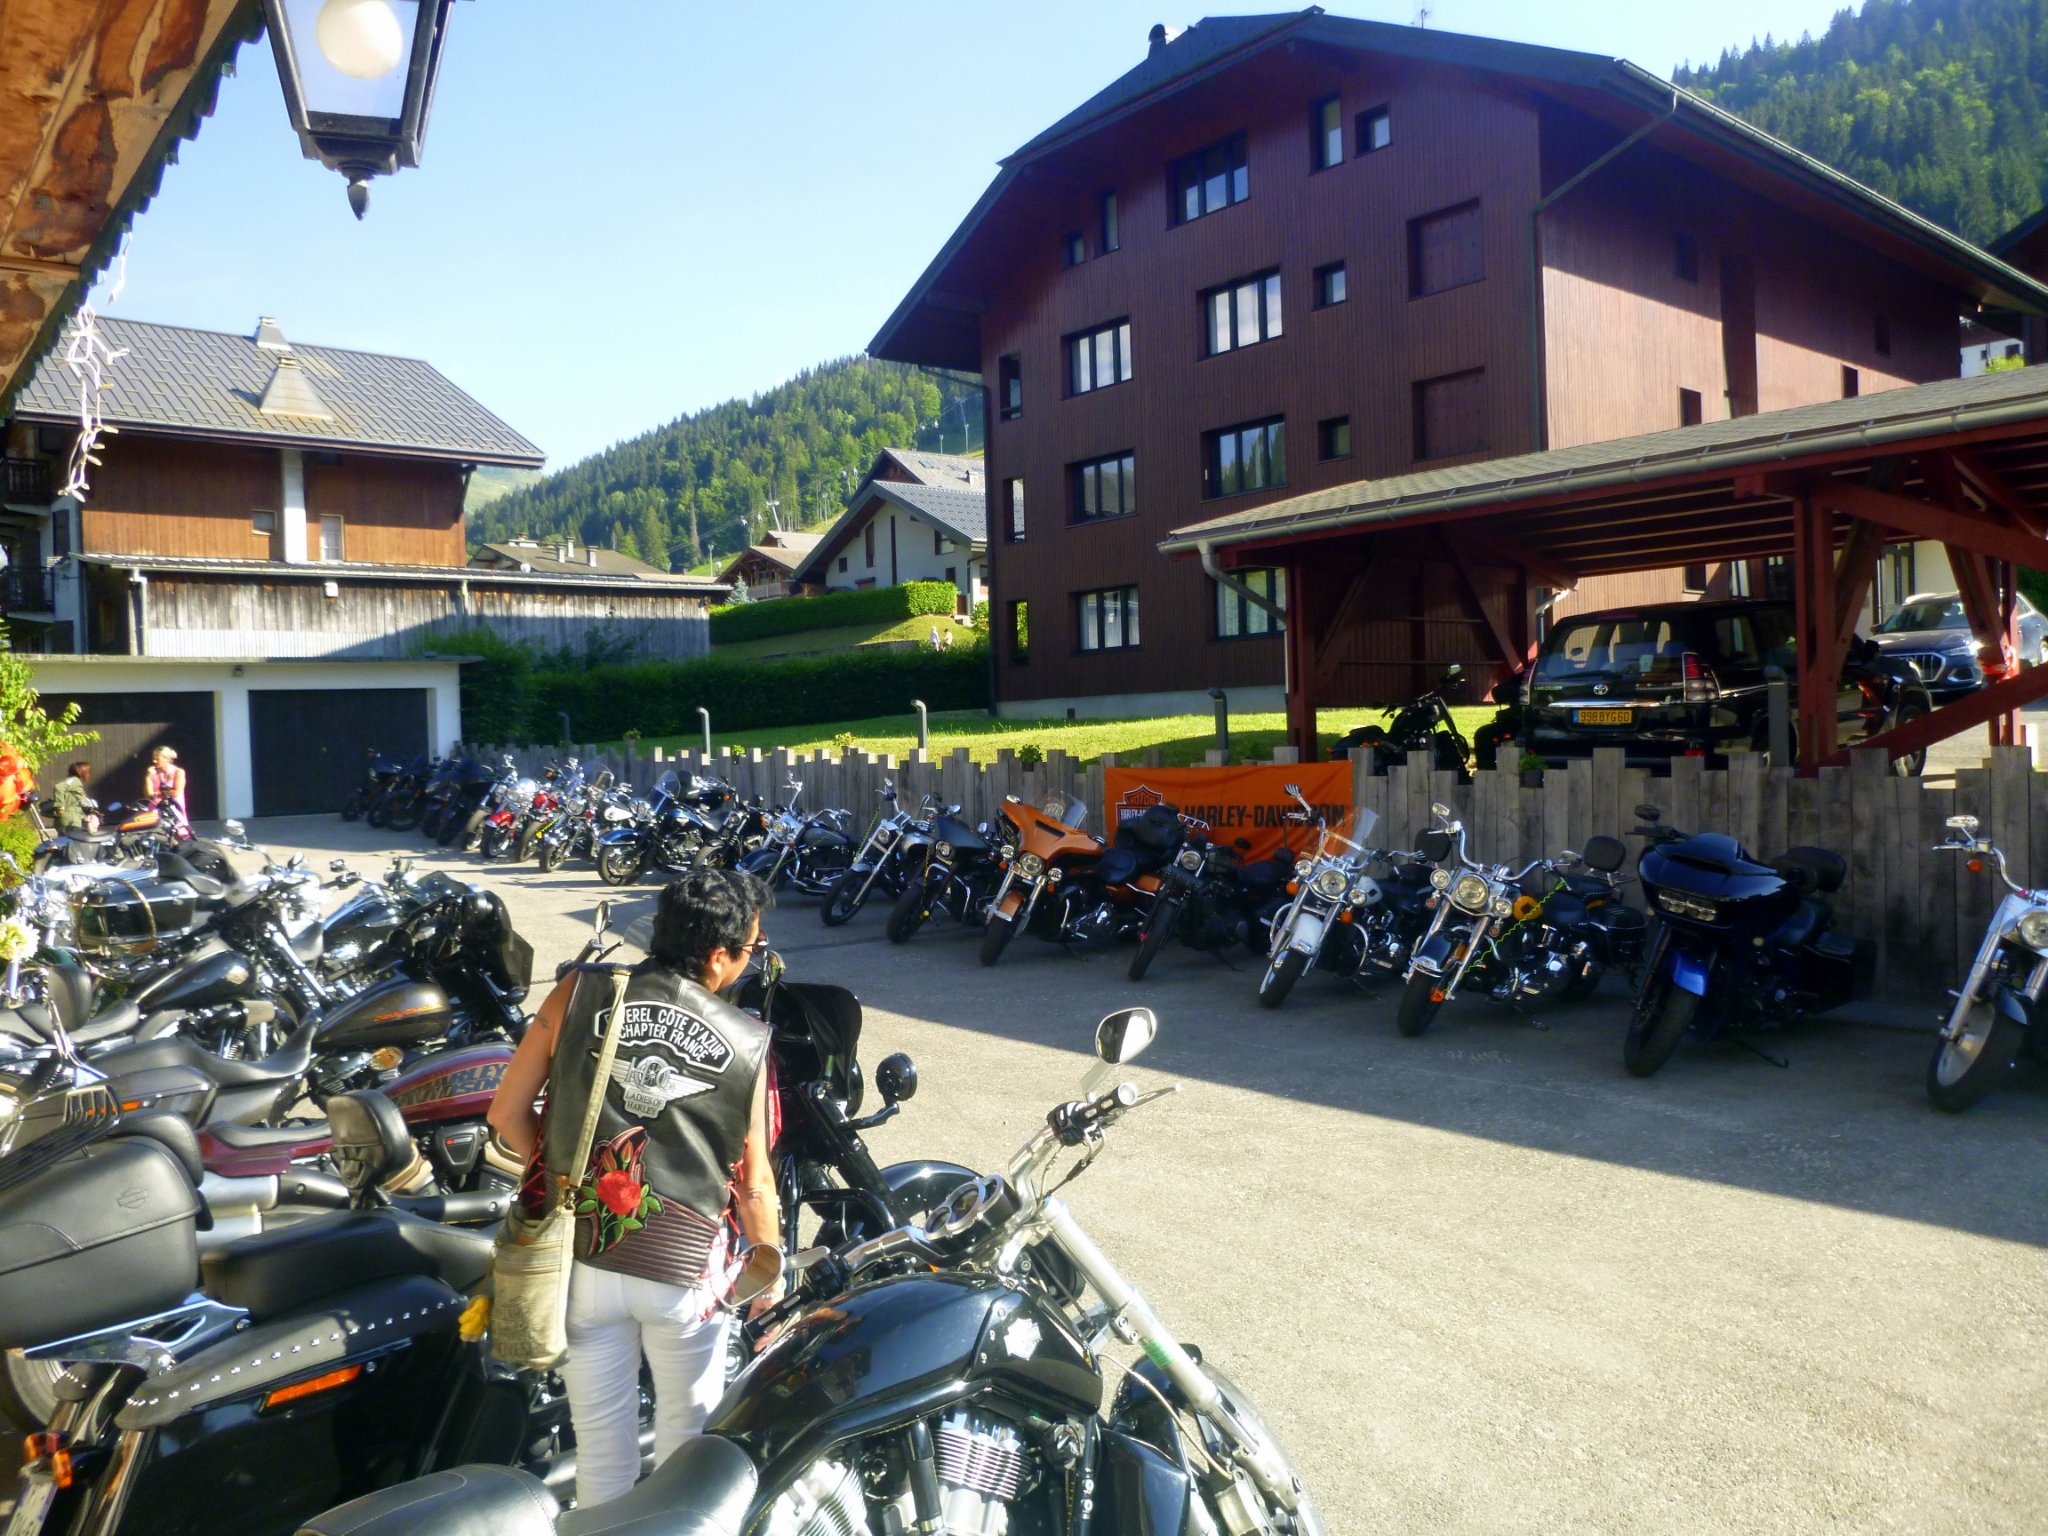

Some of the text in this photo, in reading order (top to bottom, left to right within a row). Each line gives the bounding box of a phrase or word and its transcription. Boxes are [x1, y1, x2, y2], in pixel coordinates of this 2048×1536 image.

[620, 1022, 709, 1062] CHAPTER FRANCE
[657, 1008, 690, 1031] CÔTE
[688, 1021, 726, 1060] D'AZUR
[625, 1089, 664, 1108] LADIES OF
[626, 1101, 658, 1116] HARLEY
